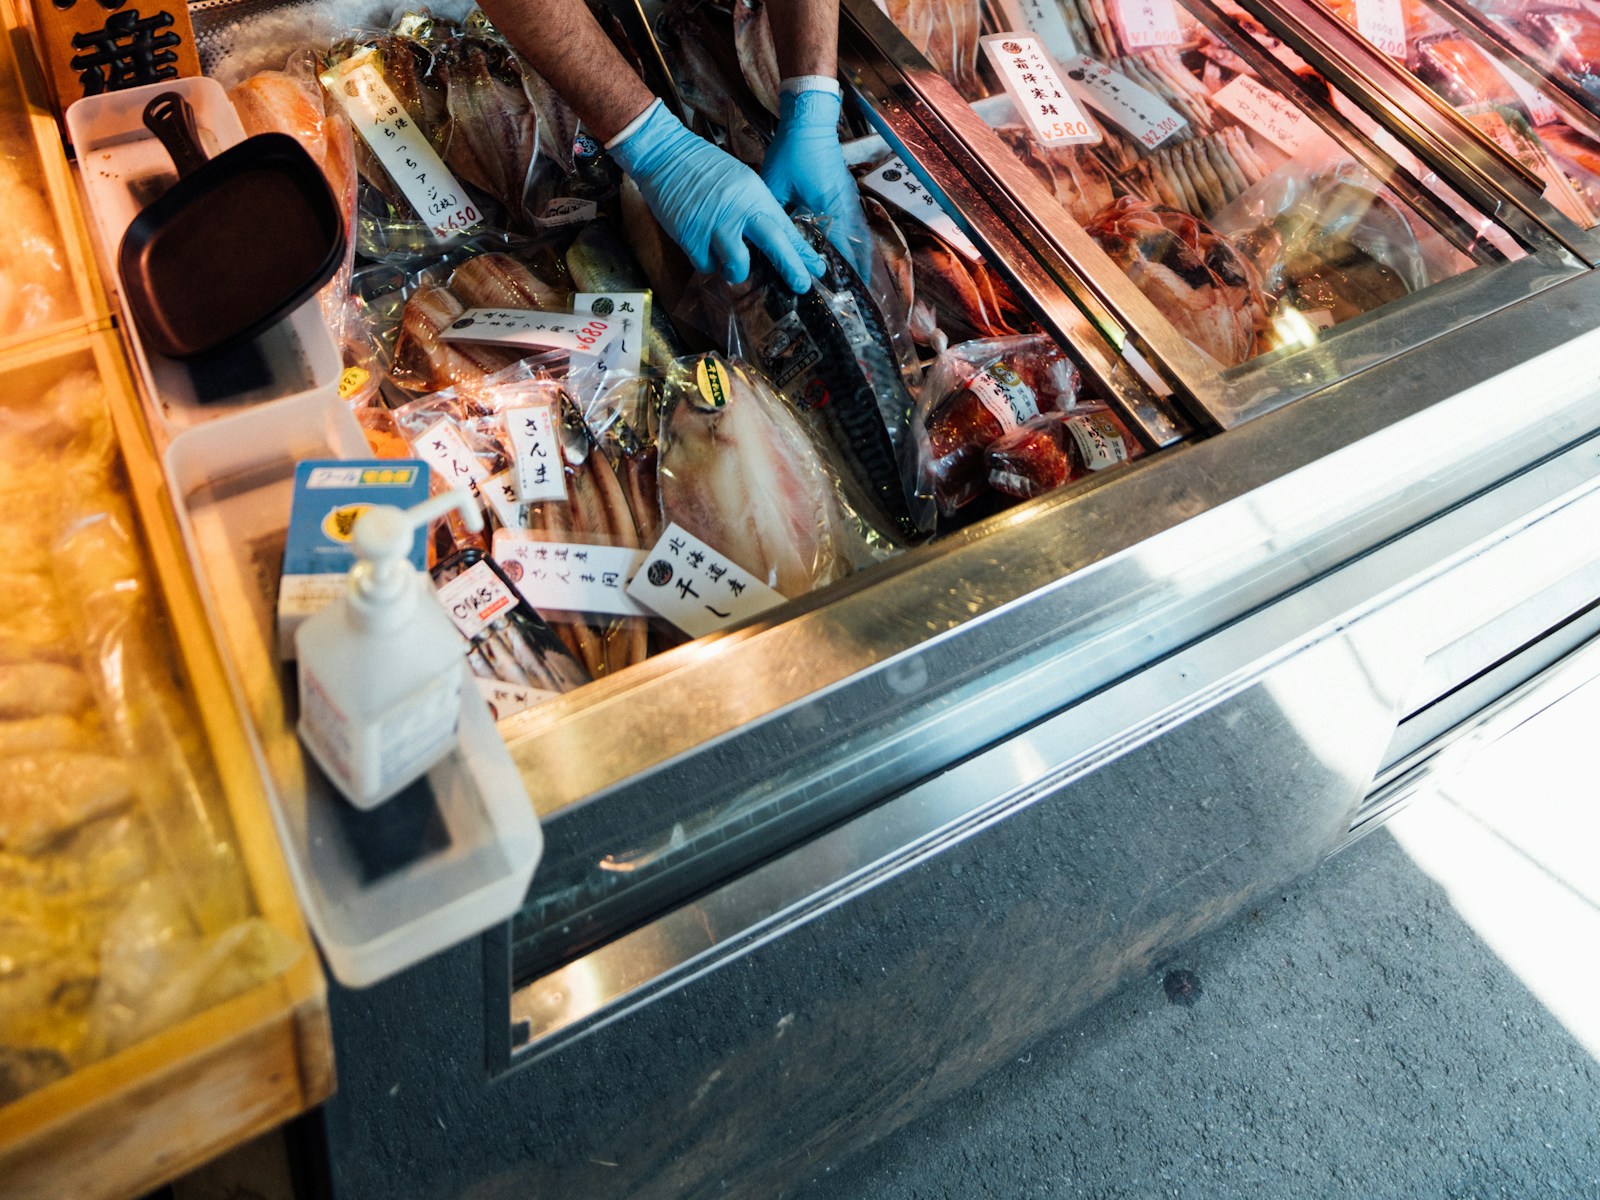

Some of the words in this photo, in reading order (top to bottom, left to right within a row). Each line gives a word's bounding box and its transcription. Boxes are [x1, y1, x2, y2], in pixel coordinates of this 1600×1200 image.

[1012, 56, 1060, 117] 霜降寒鯖
[1024, 42, 1063, 100] ノルウェー産
[1041, 119, 1089, 141] ¥580
[1141, 116, 1178, 145] ¥2,300
[373, 112, 438, 201] んちっちアジ
[428, 193, 458, 217] (2枚)
[432, 204, 478, 240] ¥650
[576, 320, 609, 351] ¥680
[617, 300, 636, 354] 丸干し
[524, 417, 550, 484] さんま
[516, 547, 588, 561] 北海道産
[668, 537, 746, 597] 北海道産
[675, 578, 731, 619] 干し
